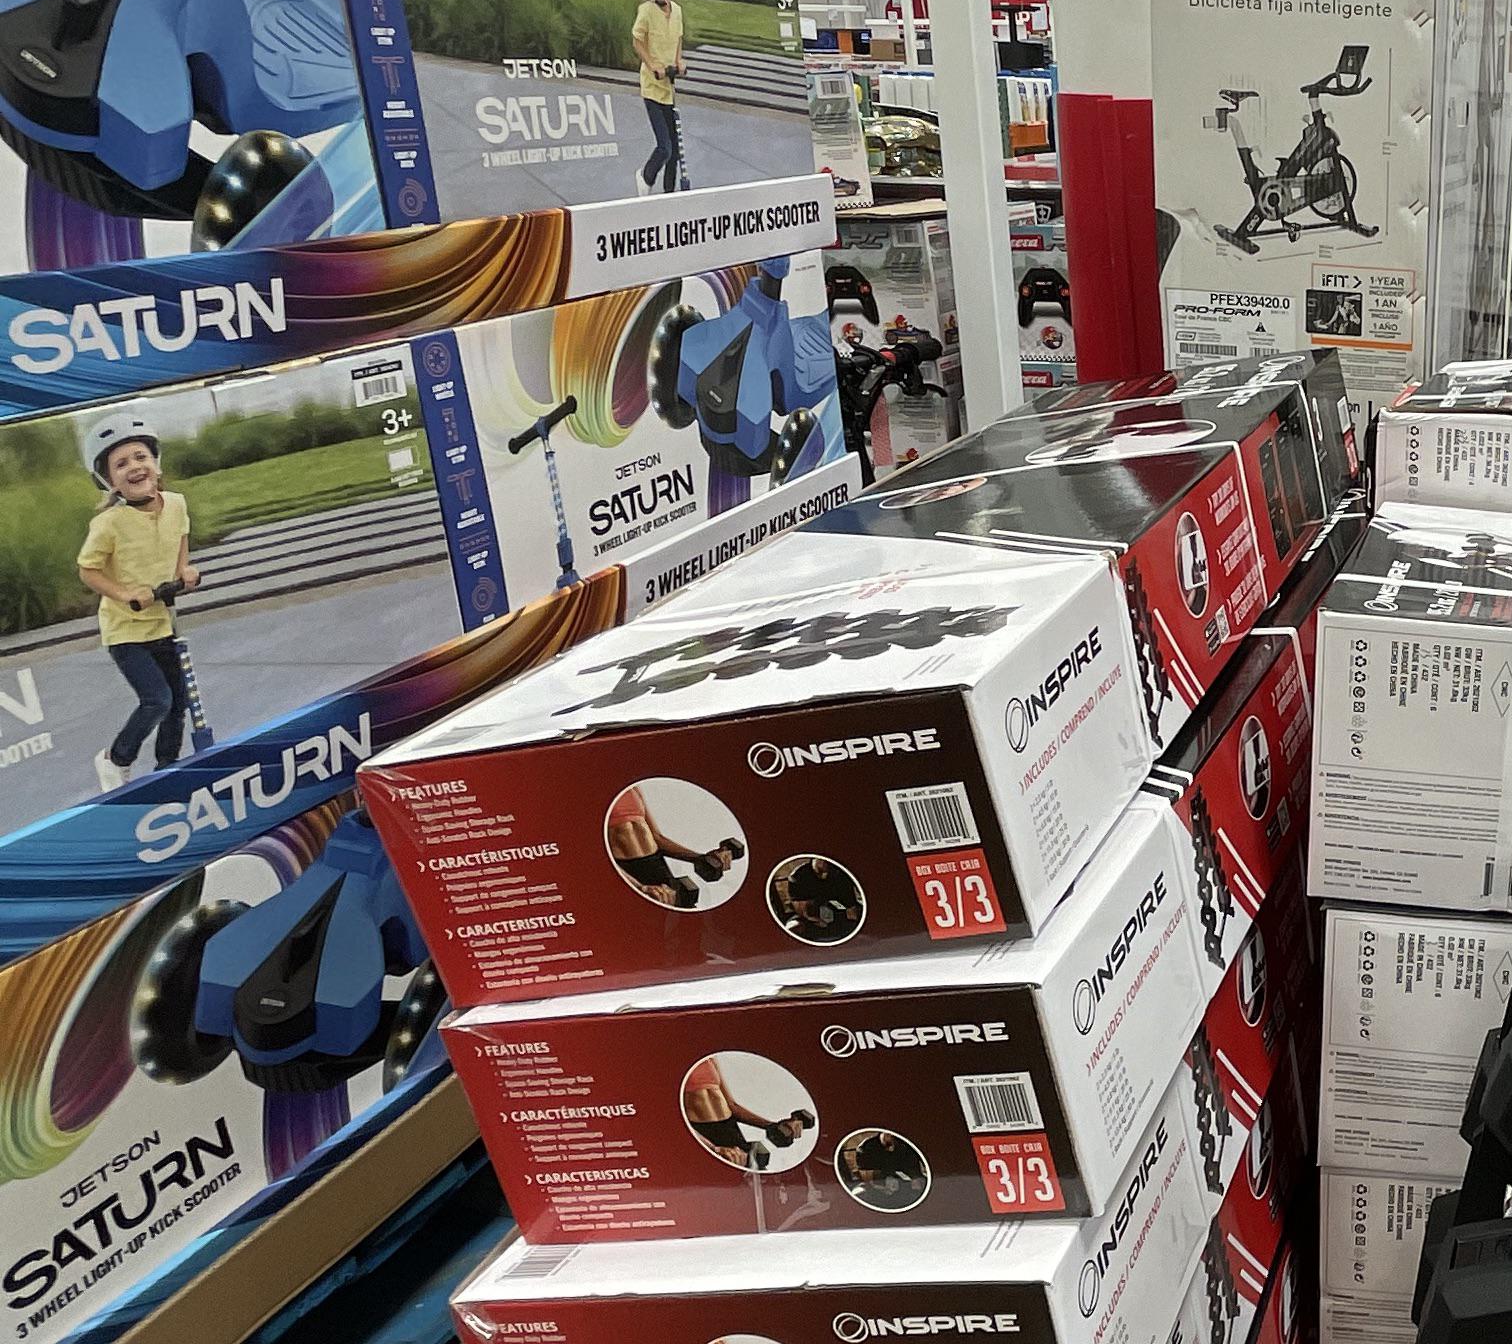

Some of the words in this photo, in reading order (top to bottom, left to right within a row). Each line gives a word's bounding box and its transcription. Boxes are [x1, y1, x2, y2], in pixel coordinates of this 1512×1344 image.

[503, 58, 578, 80] JETSON
[475, 93, 616, 144] SATURN
[596, 234, 608, 262] 3
[610, 224, 664, 260] WHEEL
[666, 215, 732, 253] LIGHT-UP
[733, 208, 765, 243] KICK
[766, 200, 821, 231] SCOOTER
[1210, 293, 1290, 309] PFEX39420.0
[1322, 274, 1348, 287] iFIT
[1174, 304, 1261, 317] PRO-FORM
[1382, 299, 1397, 308] AN
[8, 277, 287, 375] SATURN
[381, 408, 413, 435] 3+
[615, 452, 662, 480] JETSON
[588, 463, 695, 536] SATURN
[593, 542, 600, 557] 3
[599, 533, 624, 555] WHEEL
[624, 519, 652, 547] LIGHT-UP
[652, 513, 669, 532] KICK
[669, 501, 698, 528] SCOOTER
[645, 578, 656, 603] 3
[658, 557, 707, 600] WHEEL
[707, 523, 767, 576] LIGHT-UP
[768, 507, 798, 543] KICK
[799, 481, 850, 528] SCOOTER
[1024, 625, 1103, 728] INSPIRE
[786, 728, 941, 767] INSPIRE
[1023, 743, 1057, 789] INCLUDES
[1060, 696, 1095, 745] COMPREND
[1098, 664, 1123, 701] INCLUYE
[135, 712, 372, 864] SATURN
[399, 779, 468, 800] FEATURES
[428, 843, 560, 871] CARACTÉRISTIQUES
[924, 874, 995, 928] 3/3
[457, 912, 576, 938] CARACTERISTICAS
[1092, 871, 1168, 1003] INSPIRE
[1089, 1009, 1124, 1069] INCLUDES
[1125, 947, 1159, 1007] COMPREND
[1162, 901, 1189, 943] INCLUYE
[484, 1042, 550, 1056] FEATURES
[854, 1021, 1009, 1051] INSPIRE
[511, 1104, 637, 1123] CARACTÉRISTIQUES
[61, 1129, 162, 1209] JETSON
[535, 1167, 650, 1185] CARACTERISTICAS
[988, 1156, 1055, 1204] 3/3
[1, 1116, 235, 1311] SATURN
[1096, 1117, 1170, 1278] INSPIRE
[15, 1323, 28, 1340] 3
[27, 1286, 84, 1330] WHEEL
[83, 1229, 148, 1290] LIGHT-UP
[149, 1203, 183, 1242] KICK
[183, 1162, 242, 1214] SCOOTER
[500, 1321, 558, 1334] EATURES
[868, 1314, 1020, 1336] INSPIRE
